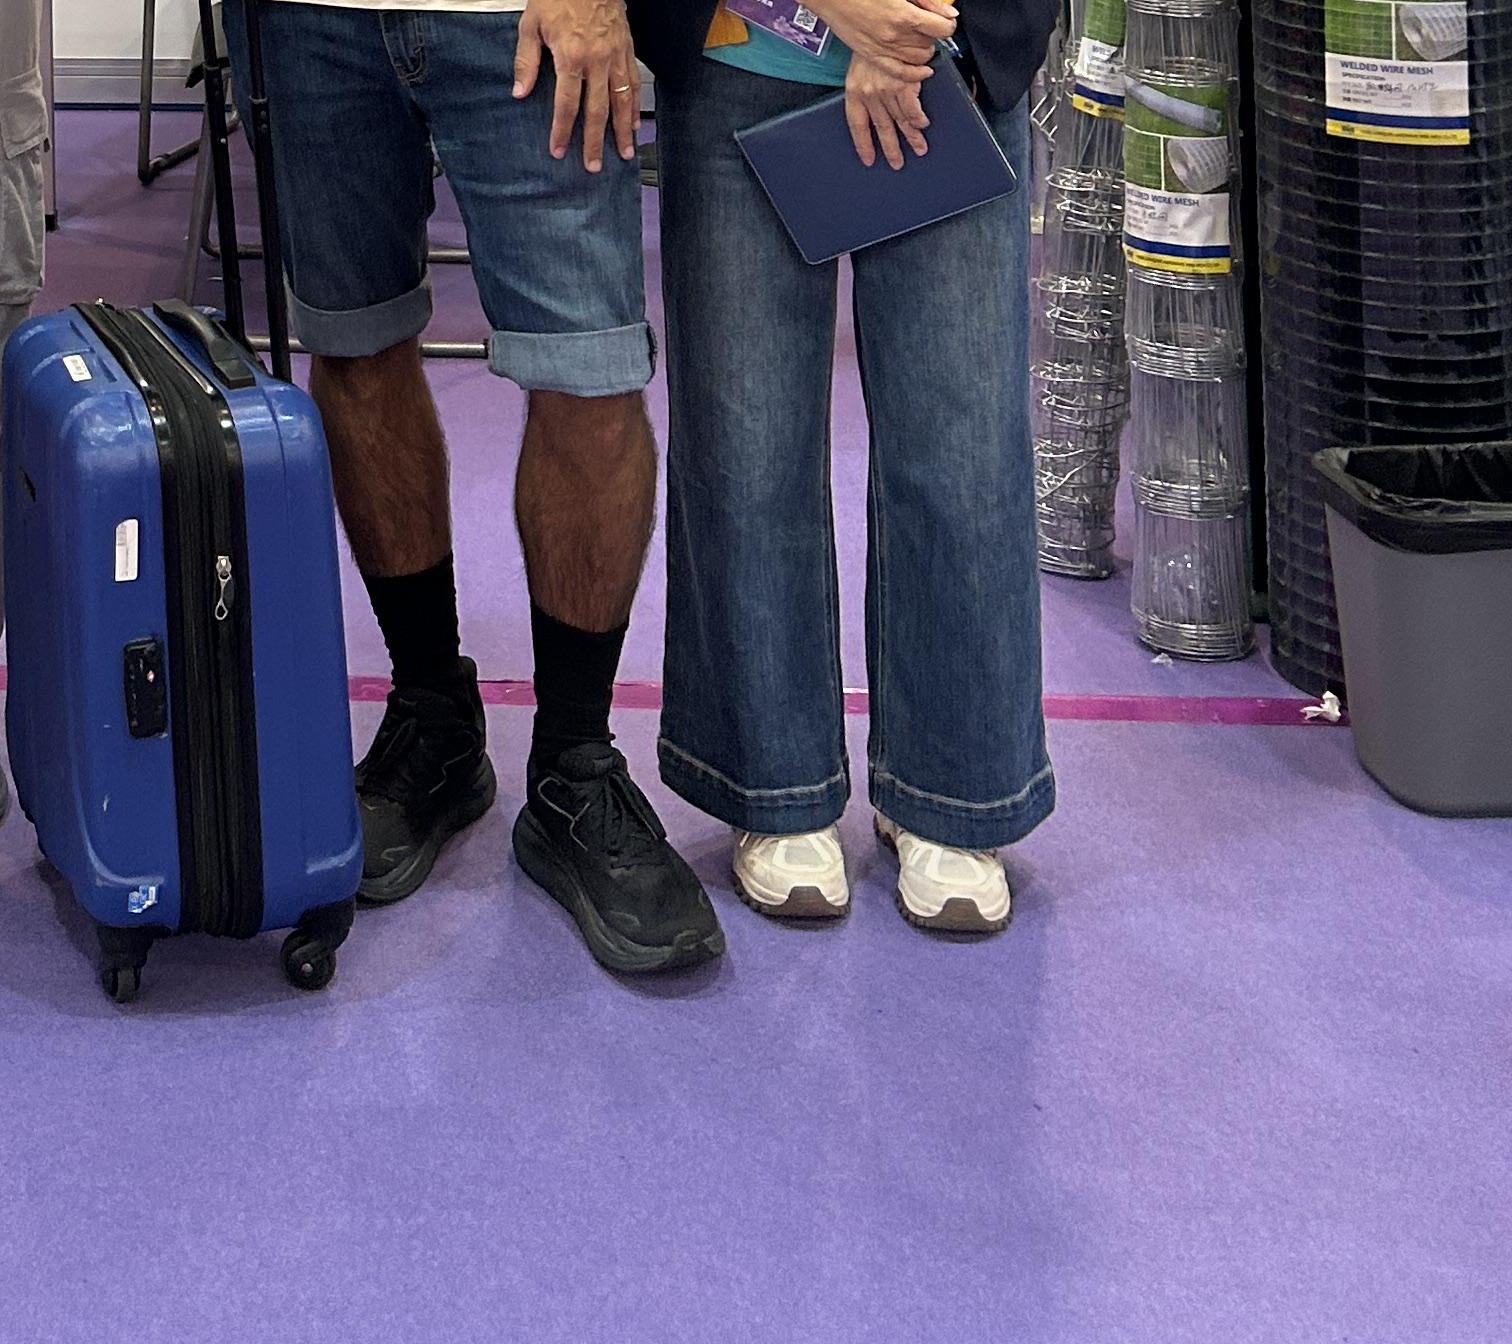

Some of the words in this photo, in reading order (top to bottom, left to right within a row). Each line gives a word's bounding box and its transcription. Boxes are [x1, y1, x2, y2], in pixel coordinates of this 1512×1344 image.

[1340, 61, 1378, 73] WELDED
[1380, 65, 1404, 74] WIRE
[1407, 67, 1433, 75] MESH
[1175, 196, 1200, 208] MESH
